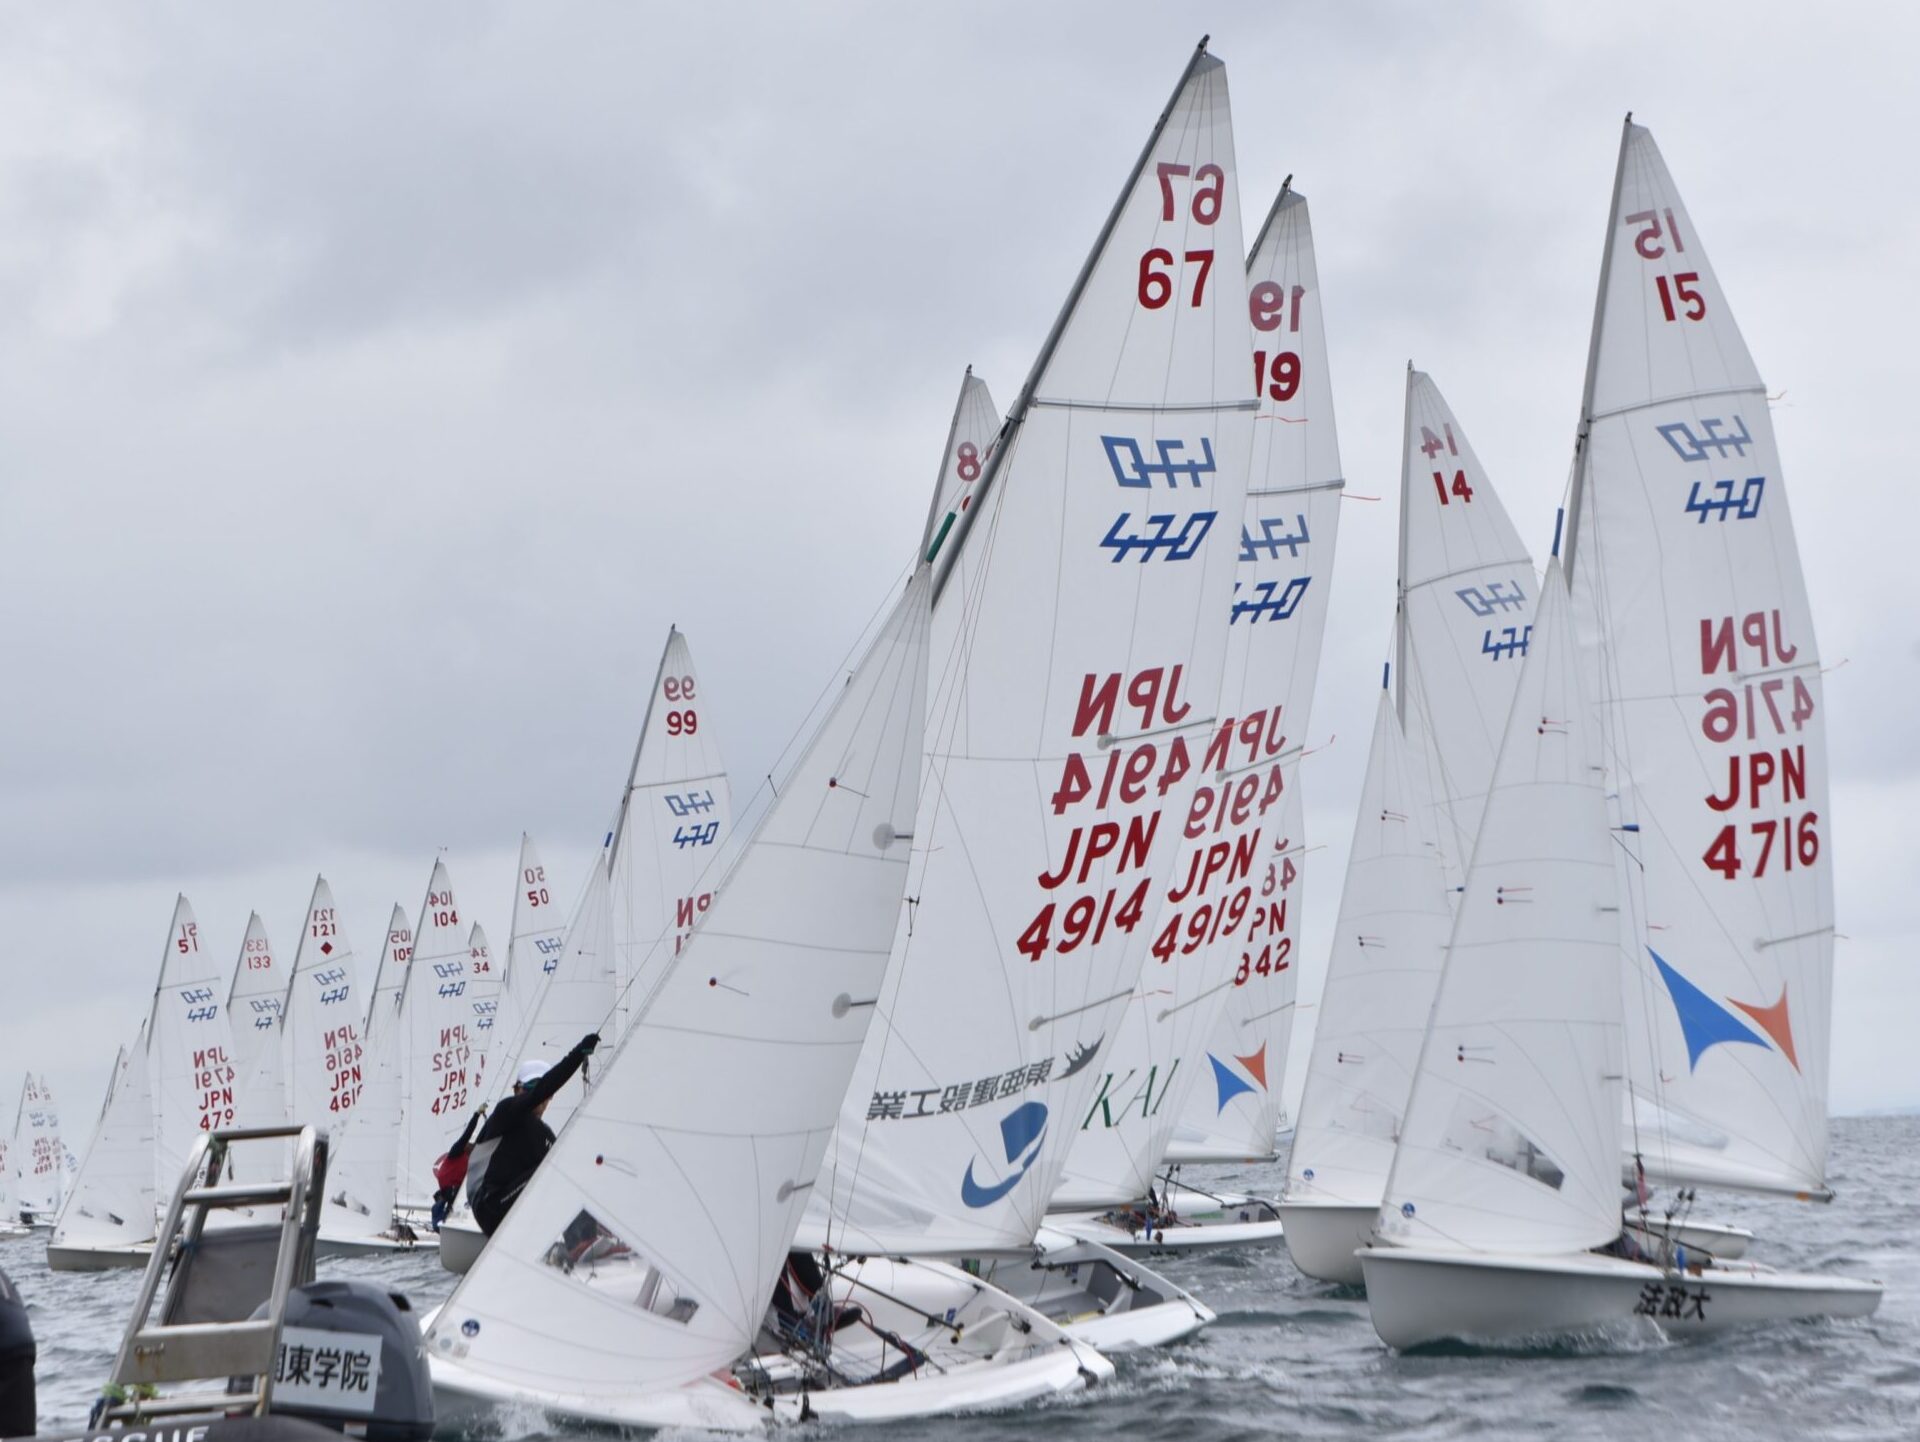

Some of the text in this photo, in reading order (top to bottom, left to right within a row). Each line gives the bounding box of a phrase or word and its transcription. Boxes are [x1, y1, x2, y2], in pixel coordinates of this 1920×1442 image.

[1138, 247, 1215, 310] 67
[1655, 271, 1706, 322] 15
[1253, 350, 1301, 402] 19
[1432, 469, 1473, 505] 14
[1684, 476, 1765, 524] 470
[1098, 510, 1219, 563] 470
[666, 709, 697, 736] 99
[1704, 744, 1806, 812] JPN
[672, 821, 719, 849] 470
[1038, 809, 1161, 889] JPN
[1702, 810, 1819, 880] 4716
[1168, 827, 1261, 903] JPN
[528, 888, 549, 906] 50
[312, 924, 336, 937] 121
[433, 910, 458, 927] 104
[1016, 878, 1151, 962] 4914
[1151, 886, 1251, 964] 4919
[178, 939, 198, 953] 51
[248, 956, 270, 970] 133
[473, 961, 490, 974] 34
[320, 986, 348, 1005] 470
[438, 981, 467, 998] 470
[187, 1005, 217, 1022] 470
[330, 1064, 361, 1092] JPN
[439, 1067, 466, 1093] JPN
[199, 1086, 232, 1110] JPN
[431, 1087, 467, 1116] 4732
